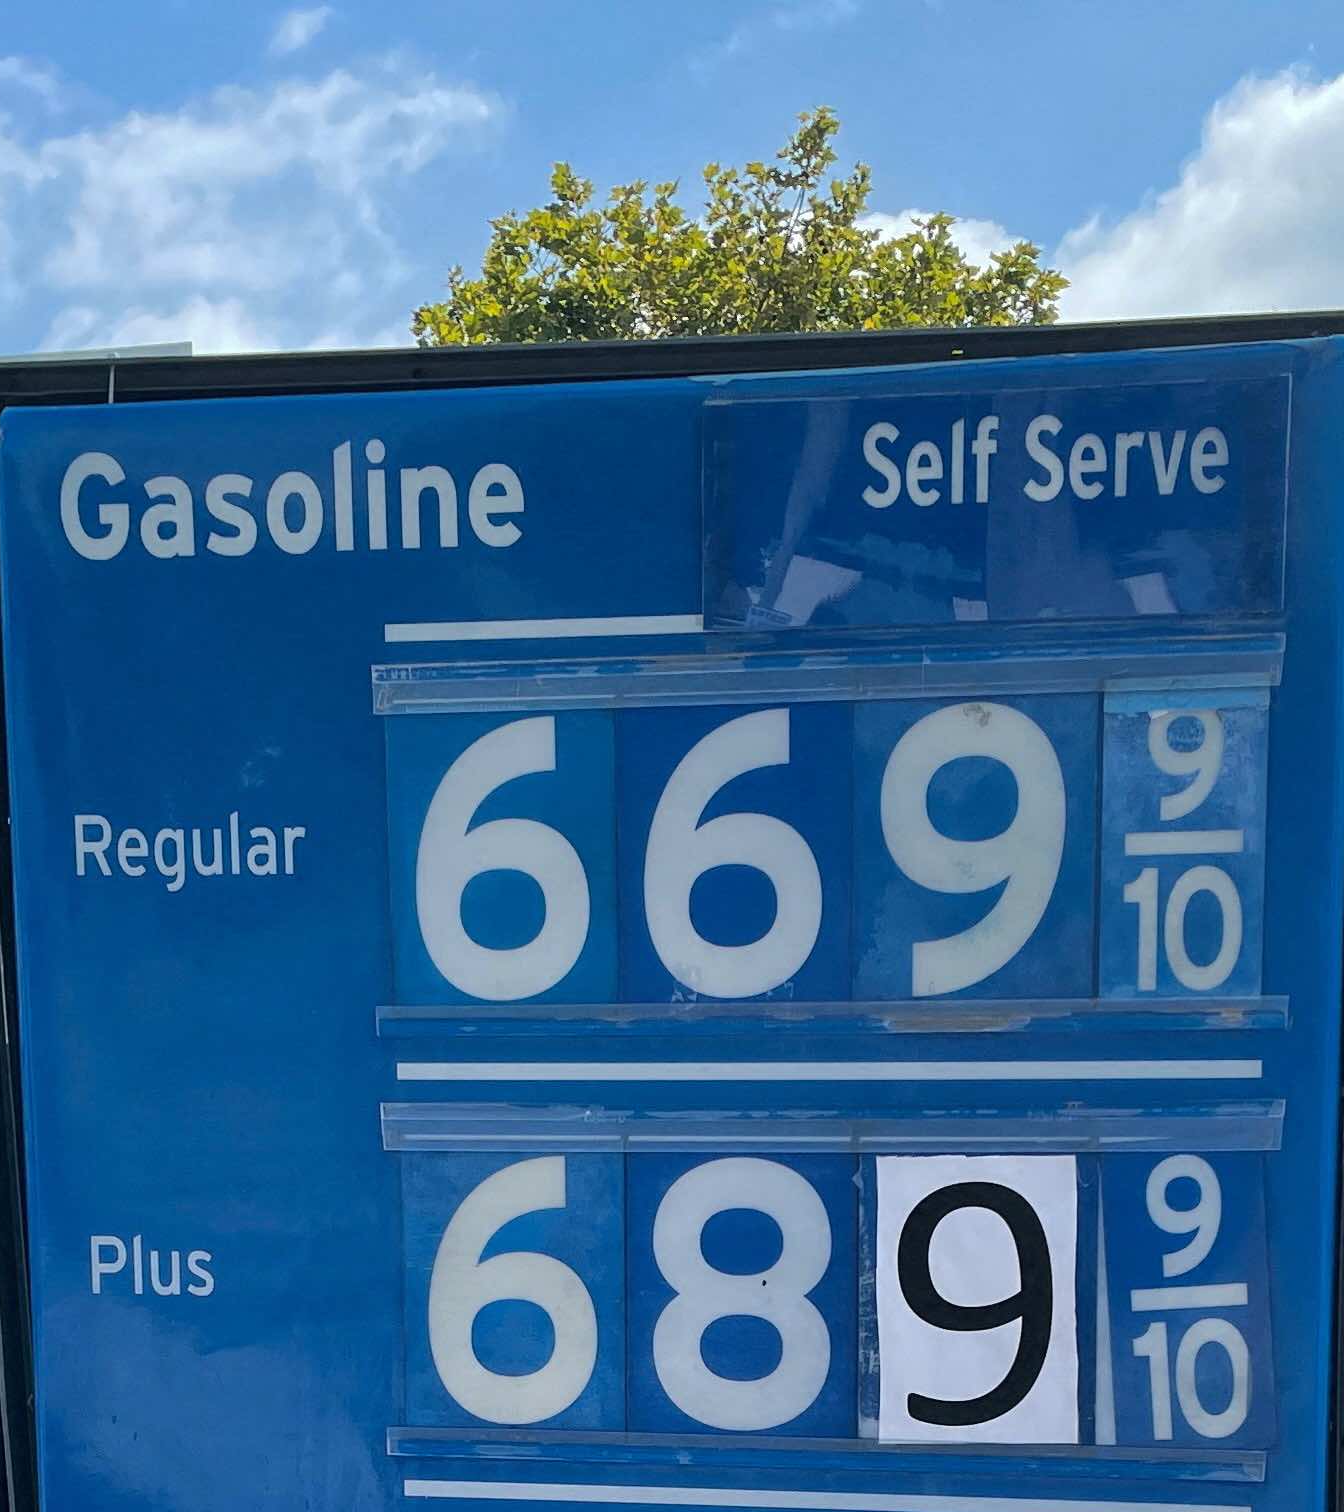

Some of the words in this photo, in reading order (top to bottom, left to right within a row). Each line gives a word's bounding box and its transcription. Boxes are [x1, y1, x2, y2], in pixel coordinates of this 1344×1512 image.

[60, 438, 525, 561] Gasoline
[862, 415, 1000, 509] Self
[1023, 414, 1229, 503] Serve
[74, 811, 306, 892] Regular
[90, 1234, 215, 1297] Plus
